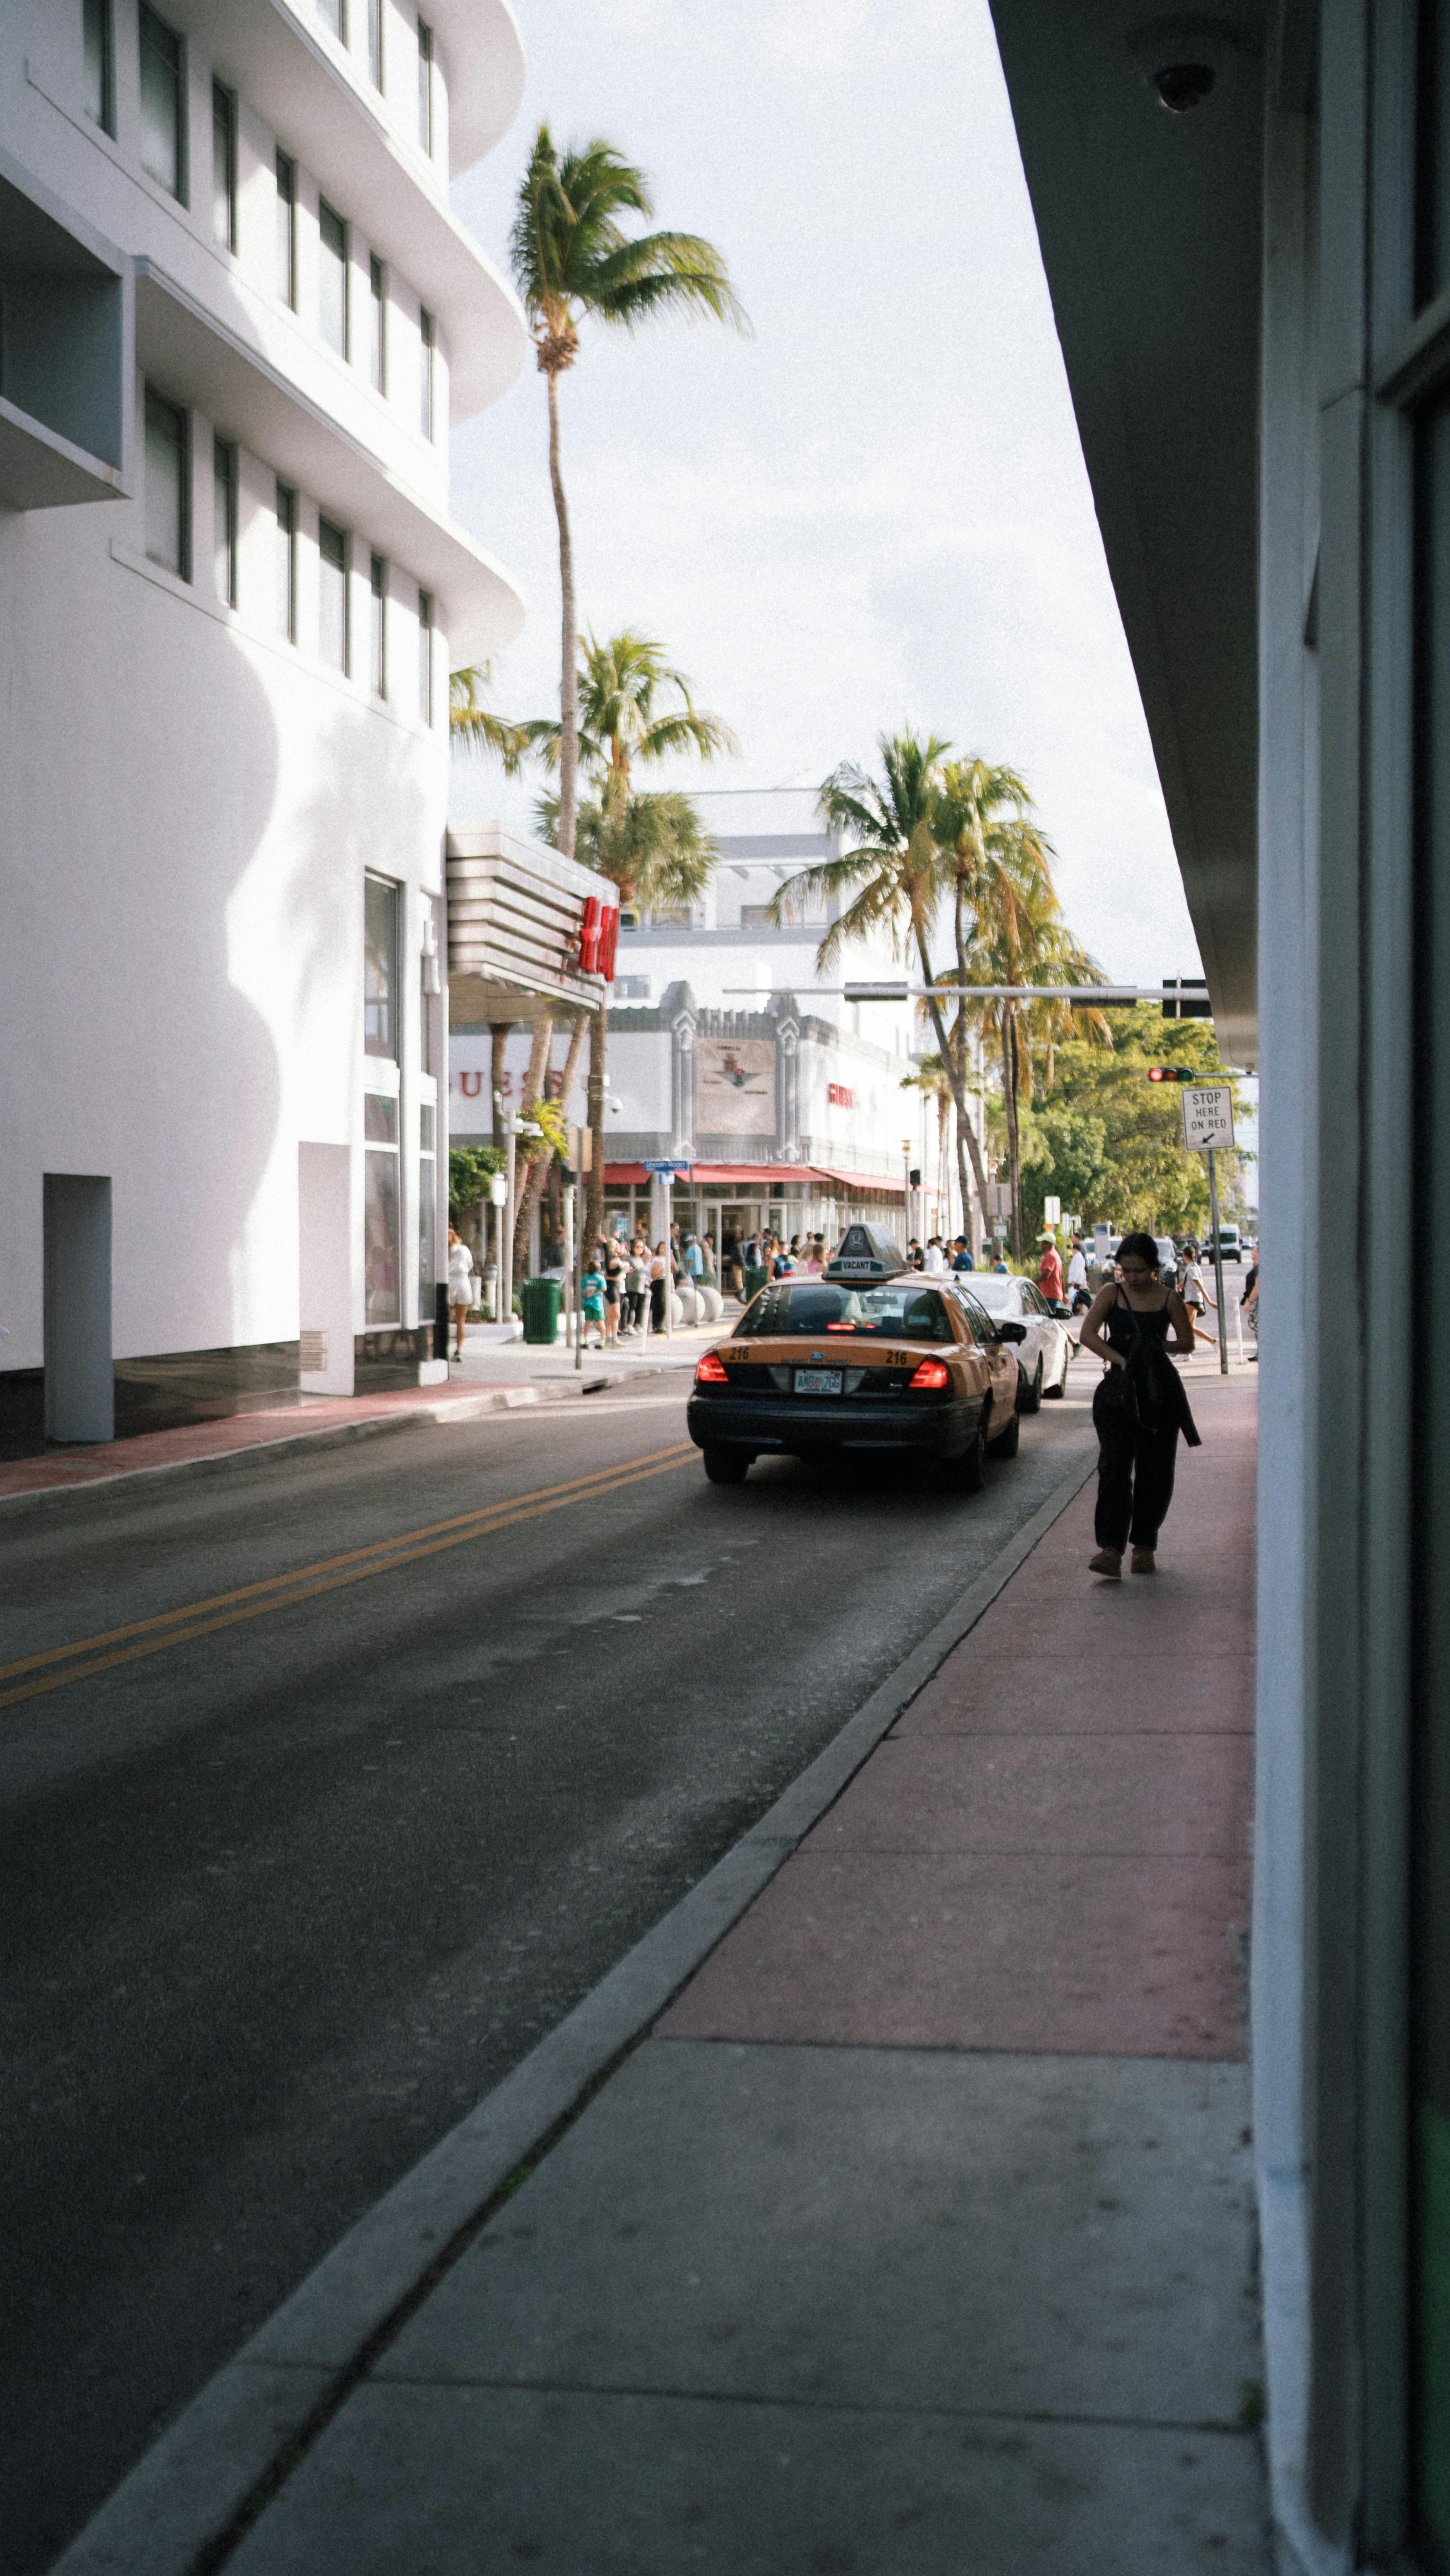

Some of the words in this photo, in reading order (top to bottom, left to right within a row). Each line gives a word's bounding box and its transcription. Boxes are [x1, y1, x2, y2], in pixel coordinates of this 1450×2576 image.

[1193, 1092, 1221, 1105] STOP
[1196, 1107, 1220, 1117] HERE
[1192, 1121, 1204, 1130] ON
[1209, 1119, 1226, 1128] RED
[843, 1261, 869, 1270] VACANT
[729, 1347, 750, 1360] 216
[886, 1350, 907, 1365] 216
